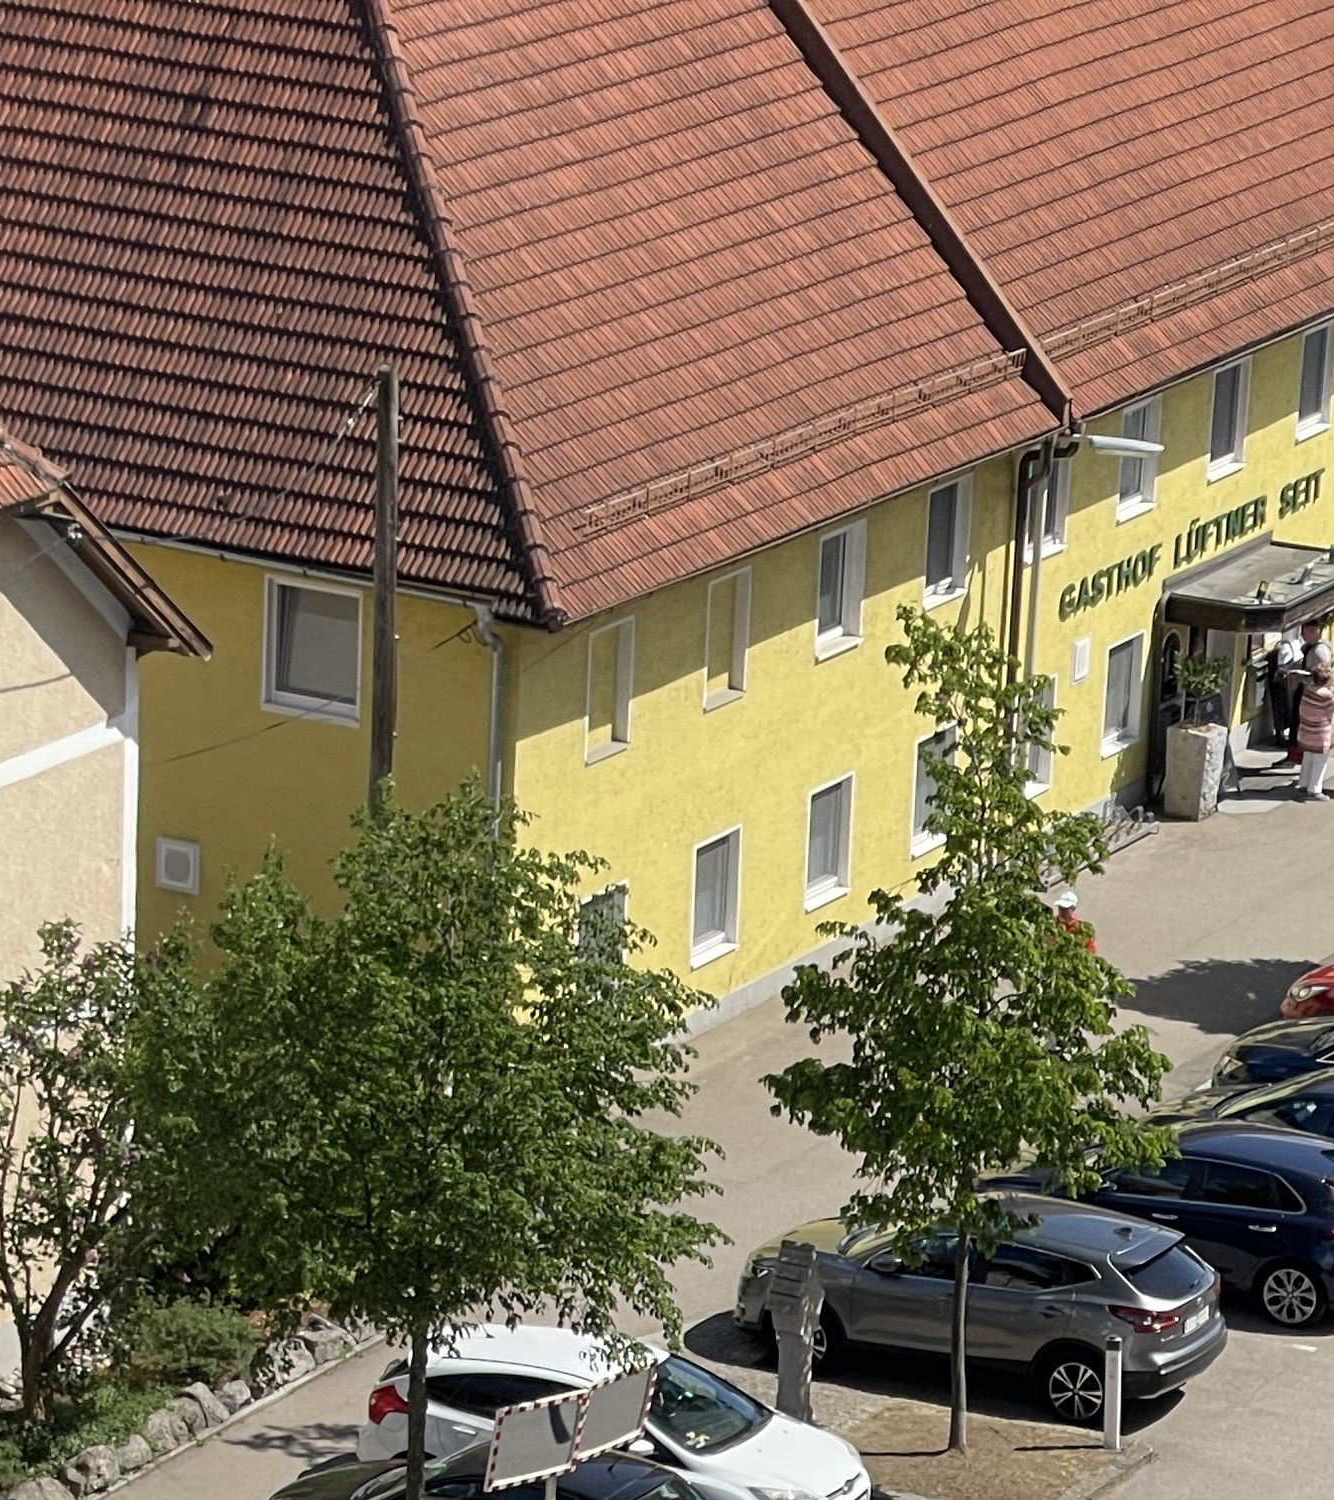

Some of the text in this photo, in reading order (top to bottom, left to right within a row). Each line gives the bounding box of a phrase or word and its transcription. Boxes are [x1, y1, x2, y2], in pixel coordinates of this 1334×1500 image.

[1058, 543, 1163, 622] GASTHOF
[1173, 495, 1267, 570] LÜFTNER
[1278, 468, 1326, 519] SEIT
